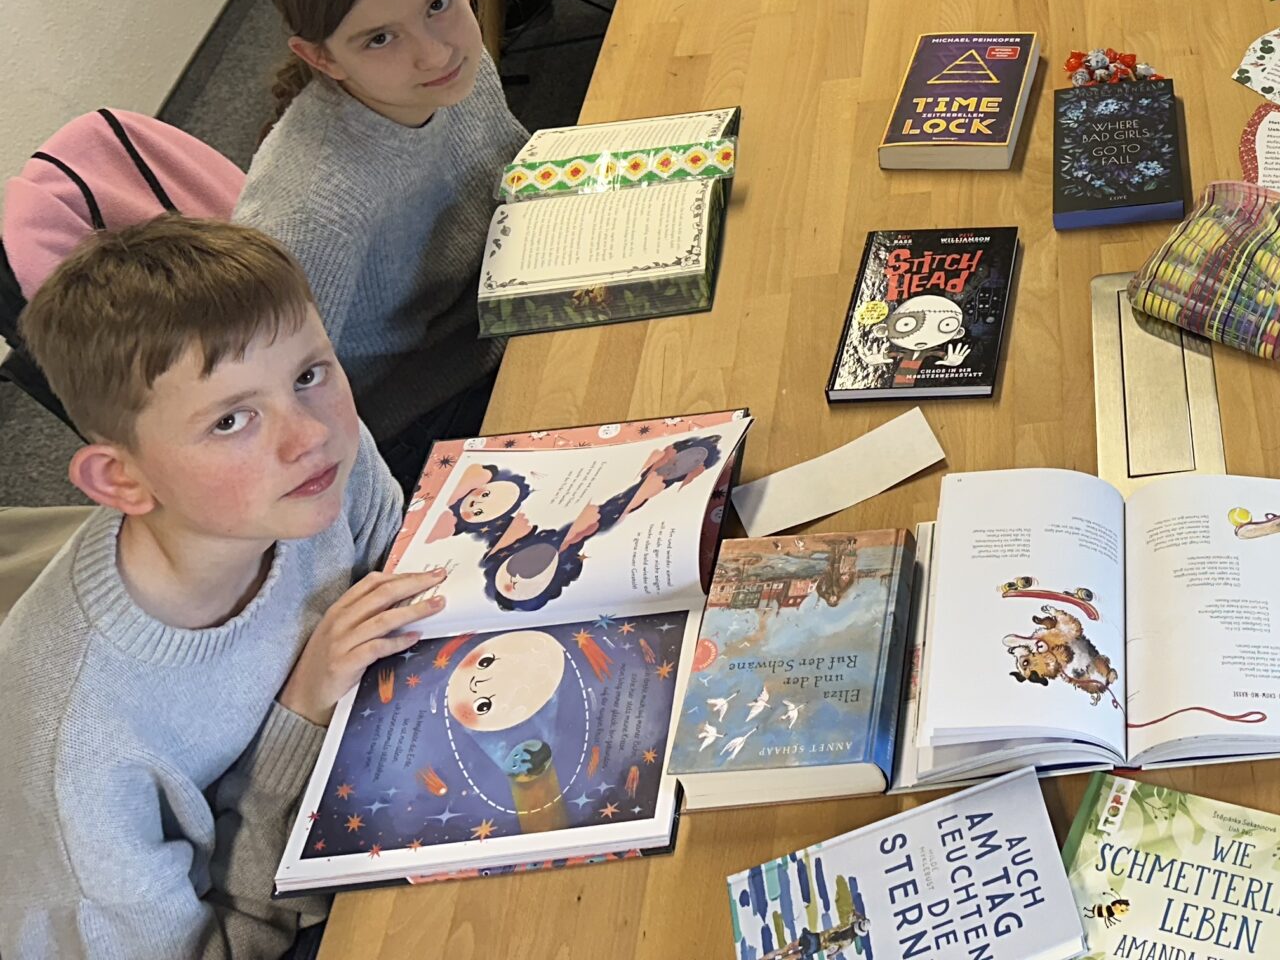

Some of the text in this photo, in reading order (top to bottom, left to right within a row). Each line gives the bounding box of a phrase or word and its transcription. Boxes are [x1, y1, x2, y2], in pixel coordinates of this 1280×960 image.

[912, 97, 1003, 113] TIME
[902, 118, 997, 135] LOCK
[1092, 119, 1140, 131] WHERE
[1082, 128, 1150, 143] BAD GIRLS
[1092, 143, 1141, 157] GO TO
[1102, 155, 1132, 166] FALL
[940, 236, 991, 244] WILLIAMSON
[728, 655, 858, 672] Ruf der Schwäne
[783, 675, 844, 688] und der
[823, 688, 861, 704] Eliza
[758, 741, 853, 756] ANNET SCHAAP
[1102, 783, 1128, 826] TOPP
[1212, 835, 1256, 869] WIE
[965, 812, 1024, 937] AM TAG
[1006, 836, 1045, 909] AUCH
[937, 814, 994, 960] LEUCHTEN
[879, 833, 932, 960] STERN
[927, 898, 959, 951] DIE
[1158, 897, 1263, 954] LEBEN
